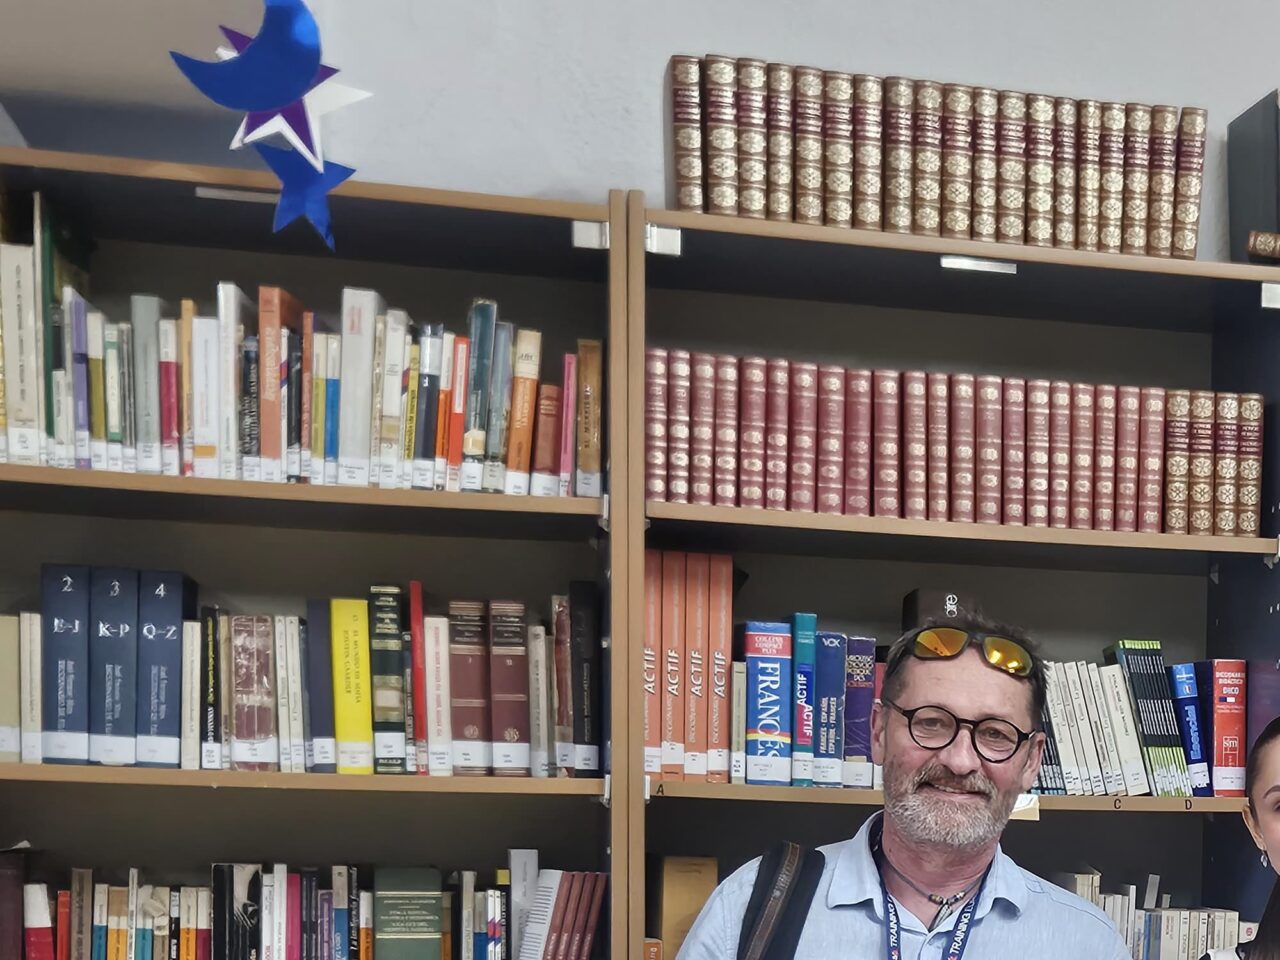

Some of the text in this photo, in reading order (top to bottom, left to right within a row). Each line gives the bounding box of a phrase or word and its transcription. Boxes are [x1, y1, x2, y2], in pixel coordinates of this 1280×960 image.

[61, 576, 74, 592] 2
[109, 580, 120, 597] 3
[154, 583, 167, 600] 4
[98, 620, 130, 638] K-P
[142, 622, 177, 640] Q-Z
[822, 638, 840, 648] VOX
[644, 647, 656, 694] ACTIF
[667, 649, 680, 696] ACTIF
[690, 650, 703, 697] ACTIF
[714, 650, 726, 697] ACTIF
[796, 674, 807, 705] ACTIF
[803, 704, 813, 737] ACTIF
[1184, 705, 1202, 760] Esencial
[656, 784, 664, 795] A
[1114, 799, 1122, 810] C
[1185, 799, 1192, 810] D
[889, 904, 898, 947] TRAINING
[949, 912, 971, 954] TRAINING
